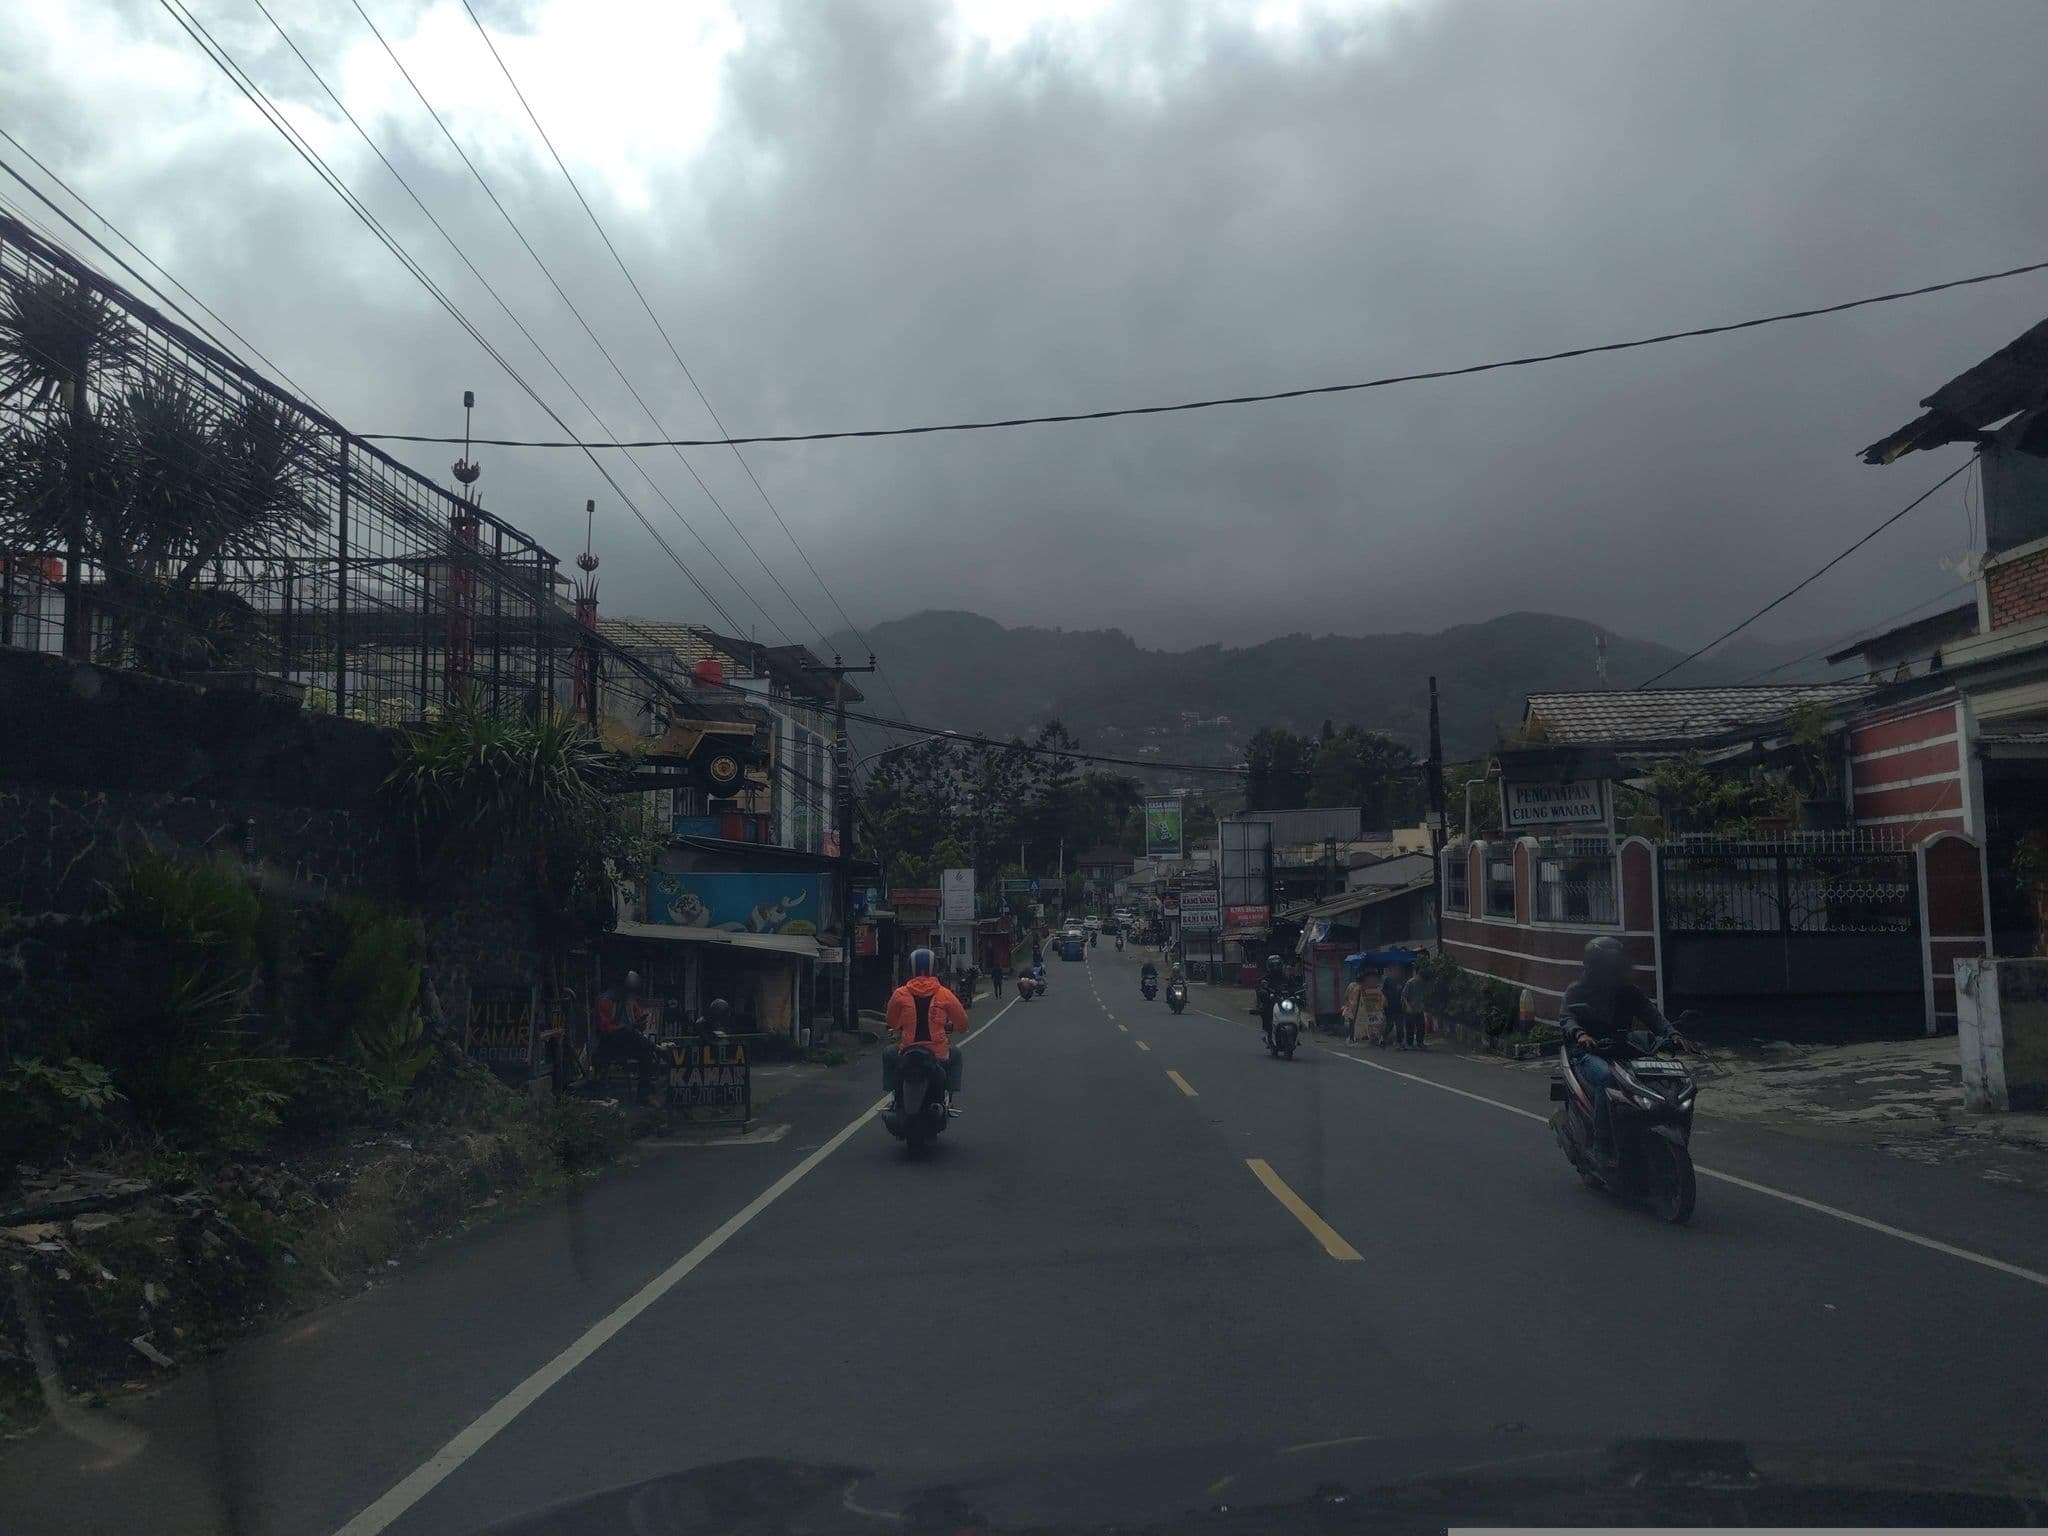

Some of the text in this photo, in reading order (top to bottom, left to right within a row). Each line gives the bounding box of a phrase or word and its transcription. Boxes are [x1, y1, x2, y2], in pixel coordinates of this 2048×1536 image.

[1513, 804, 1597, 820] CIUNG WANARA
[471, 1002, 530, 1024] VILLA
[468, 1025, 529, 1047] KAMAR
[672, 1045, 745, 1065] VILLA
[671, 1066, 745, 1087] KAMAR
